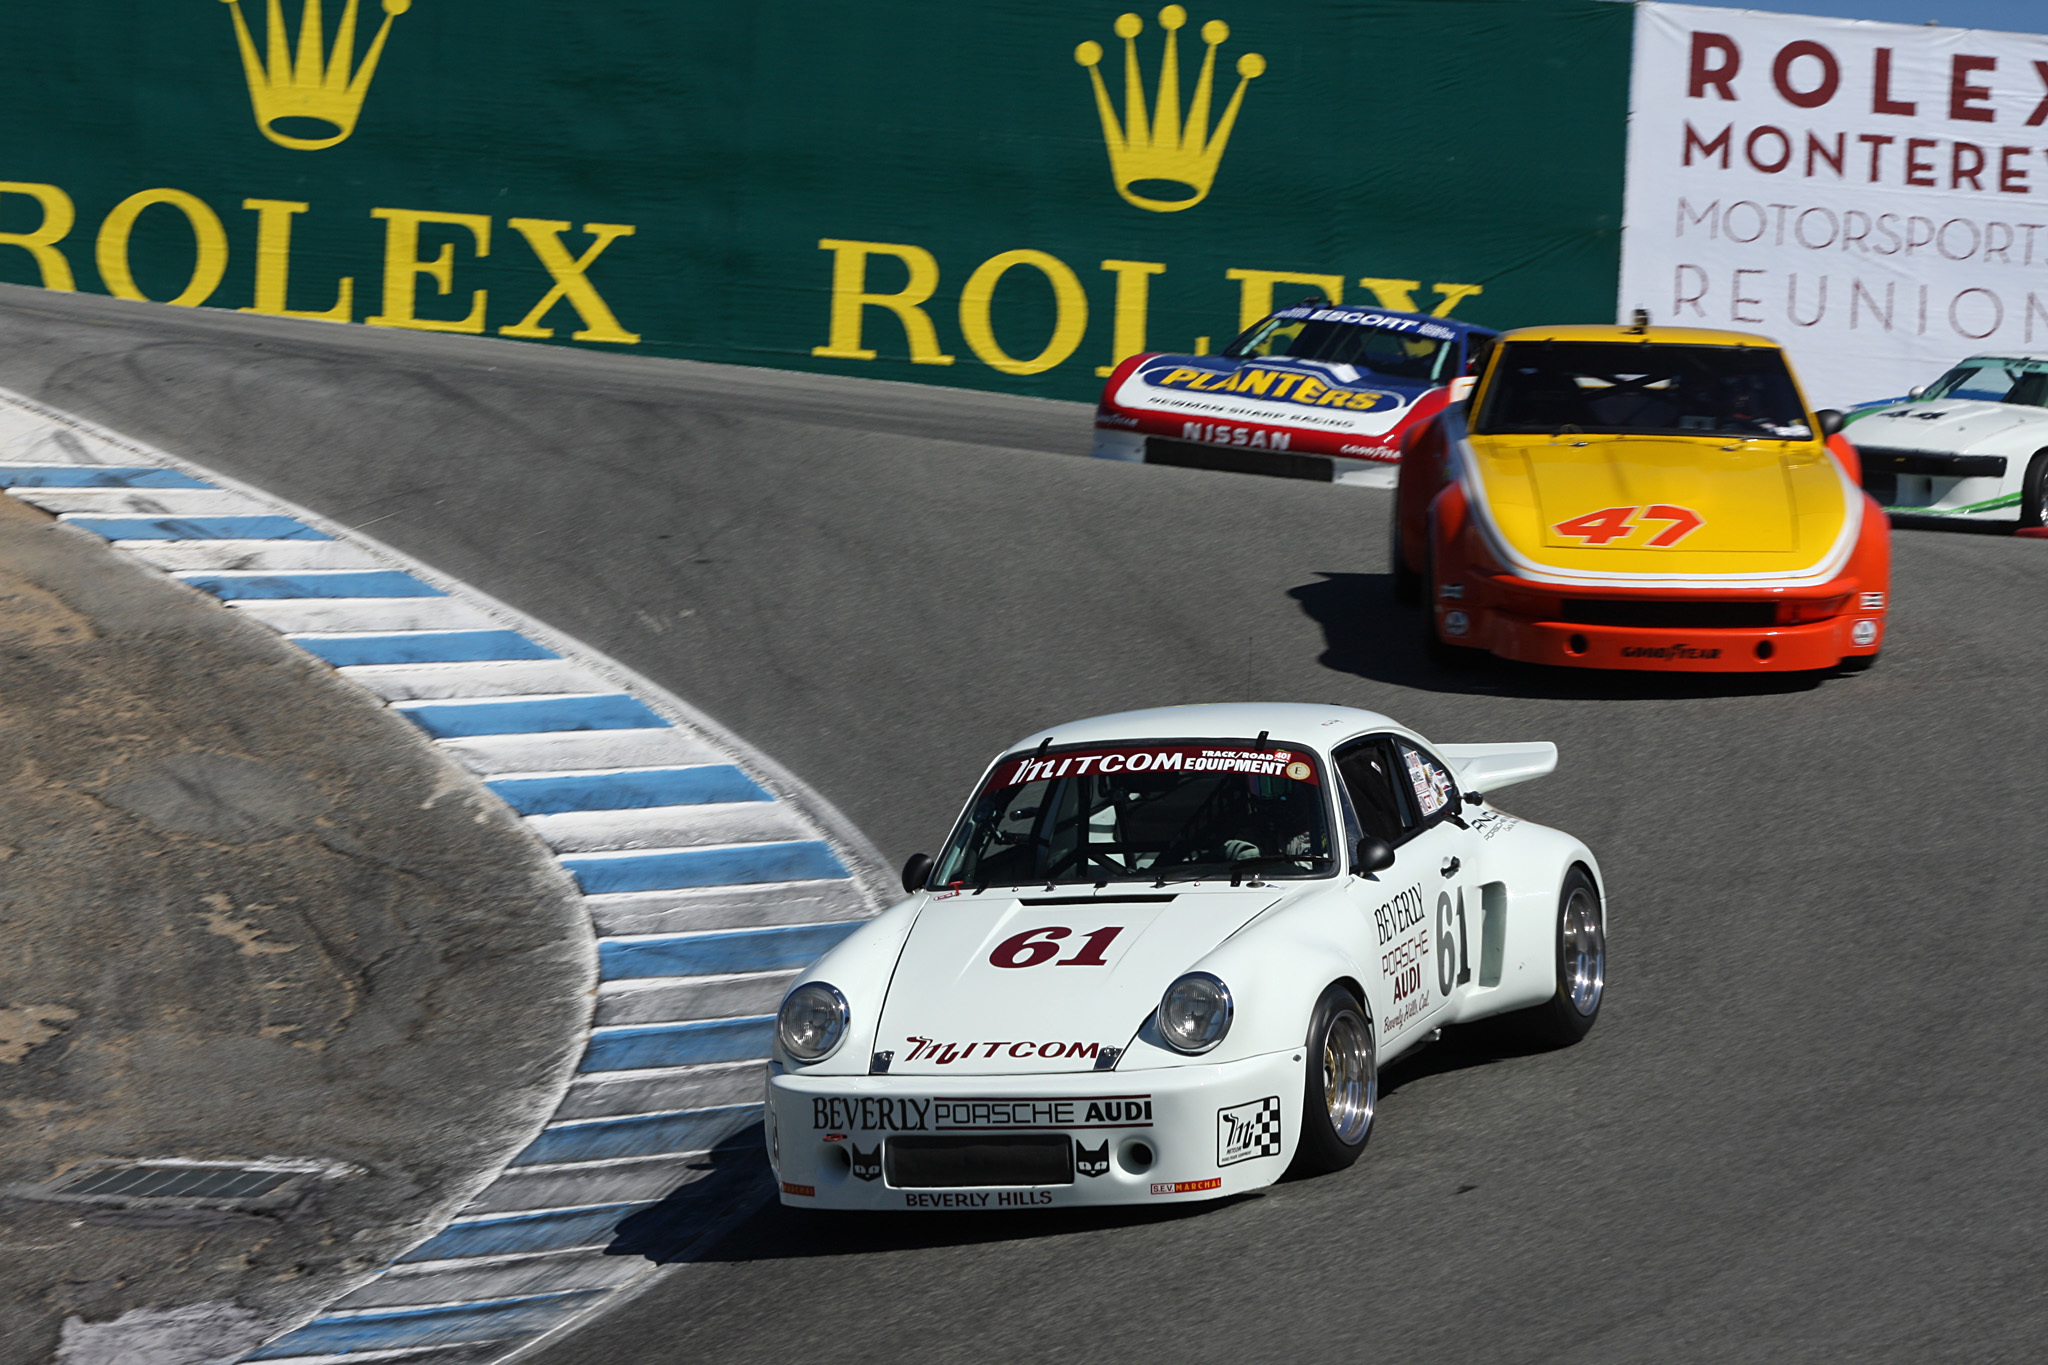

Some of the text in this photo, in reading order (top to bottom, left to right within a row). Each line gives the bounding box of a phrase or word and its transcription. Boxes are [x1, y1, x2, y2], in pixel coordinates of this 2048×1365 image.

[1682, 118, 2048, 194] MONTERE
[1676, 197, 2048, 267] MOTORSPORT
[1309, 309, 1419, 331] ESCORT
[1160, 368, 1383, 411] PLANTERS
[1183, 421, 1291, 450] NISSAN
[1549, 503, 1708, 548] 47
[1009, 752, 1183, 785] MITCOM
[1184, 758, 1285, 775] EQUIPMENT
[1202, 750, 1274, 760] TRACK/ROAD
[1374, 882, 1426, 947] BEVERLY
[989, 926, 1125, 969] 61
[1382, 929, 1429, 980] PORSCHE
[1436, 885, 1471, 997] 61
[1393, 962, 1421, 1005] AUDI
[905, 1036, 1099, 1064] MITCOM
[813, 1097, 1153, 1131] BEVERLY PORSCHE AUDI
[906, 1189, 1053, 1207] BEVERLY HILLS
[1176, 1180, 1221, 1191] MARCHAL
